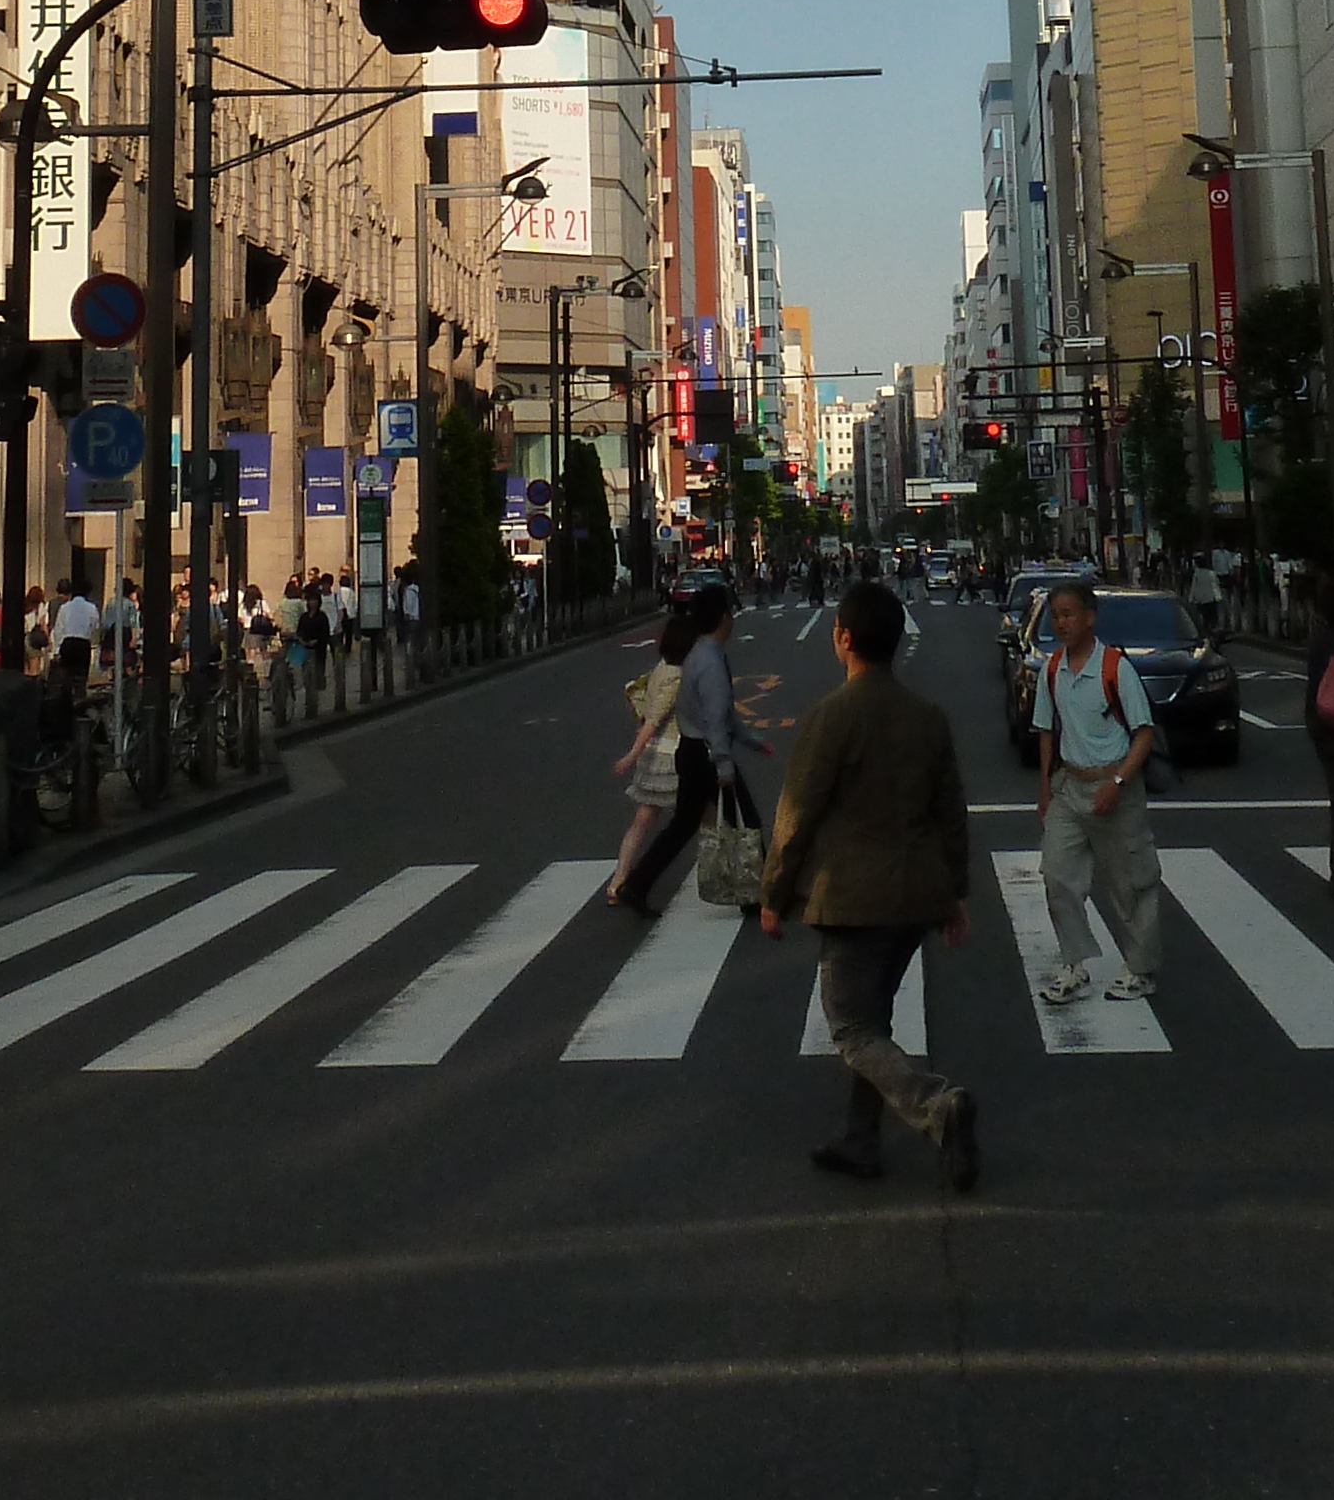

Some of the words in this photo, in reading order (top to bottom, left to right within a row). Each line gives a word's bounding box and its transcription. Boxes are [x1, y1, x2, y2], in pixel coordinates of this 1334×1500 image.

[512, 96, 550, 114] SHORTS
[502, 204, 556, 240] VER
[565, 210, 587, 242] 21
[1066, 233, 1076, 256] ONE
